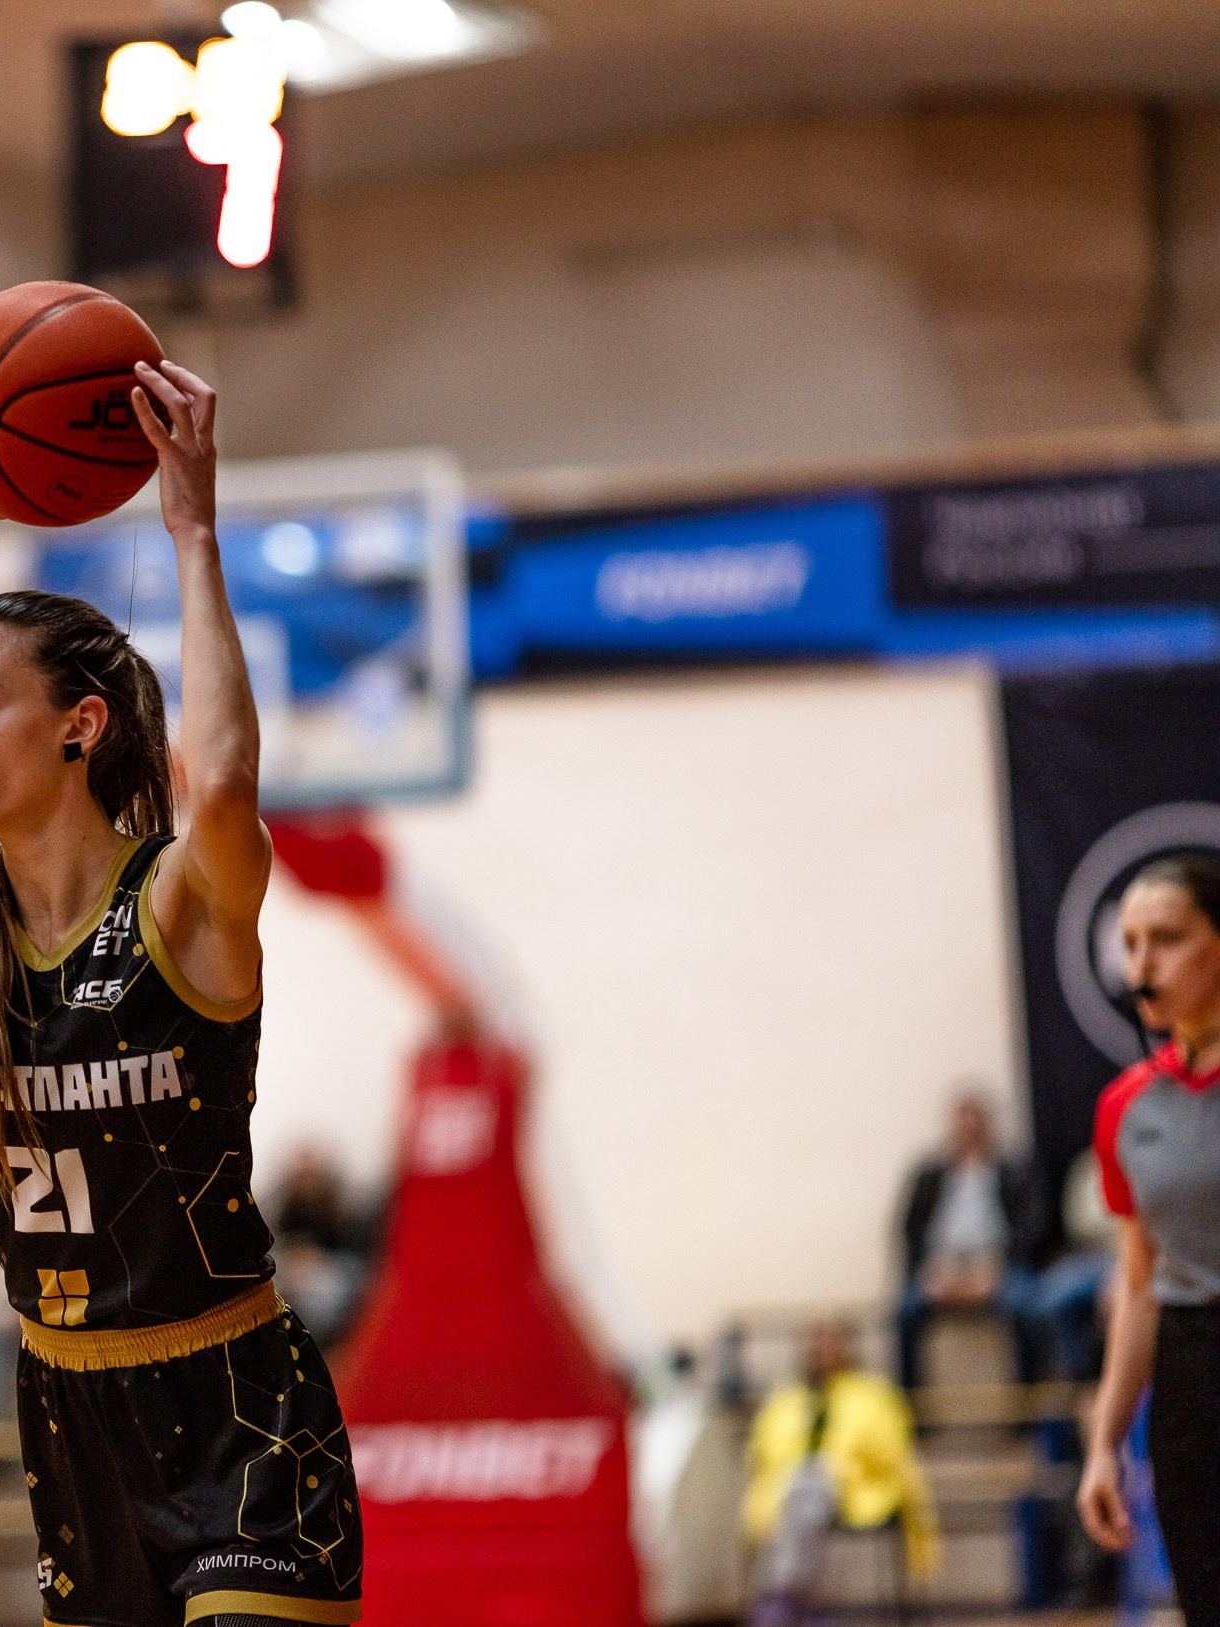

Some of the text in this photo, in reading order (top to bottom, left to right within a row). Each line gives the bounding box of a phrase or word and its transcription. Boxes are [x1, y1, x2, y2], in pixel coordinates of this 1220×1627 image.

[69, 390, 139, 430] JÖ
[98, 904, 133, 932] ON
[92, 931, 130, 957] ET
[0, 1050, 182, 1112] ТЛАНТА
[6, 1146, 95, 1234] 21
[196, 1554, 296, 1573] ХИМПРОМ
